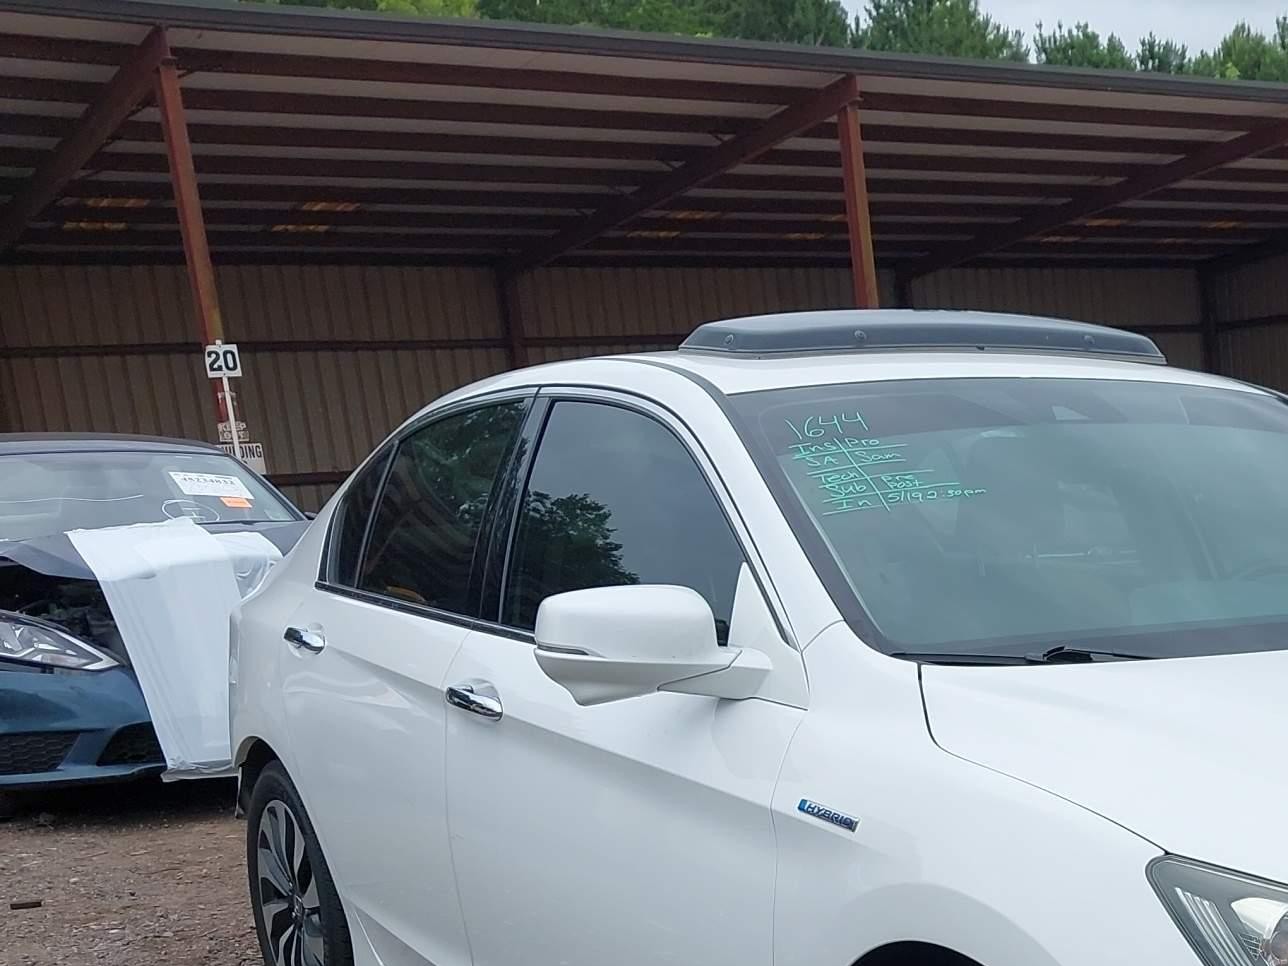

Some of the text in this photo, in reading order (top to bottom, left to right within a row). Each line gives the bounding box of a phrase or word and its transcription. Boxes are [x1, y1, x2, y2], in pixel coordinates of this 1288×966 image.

[206, 350, 238, 372] 20
[785, 411, 868, 440] 1644
[807, 803, 853, 828] HYBRID
